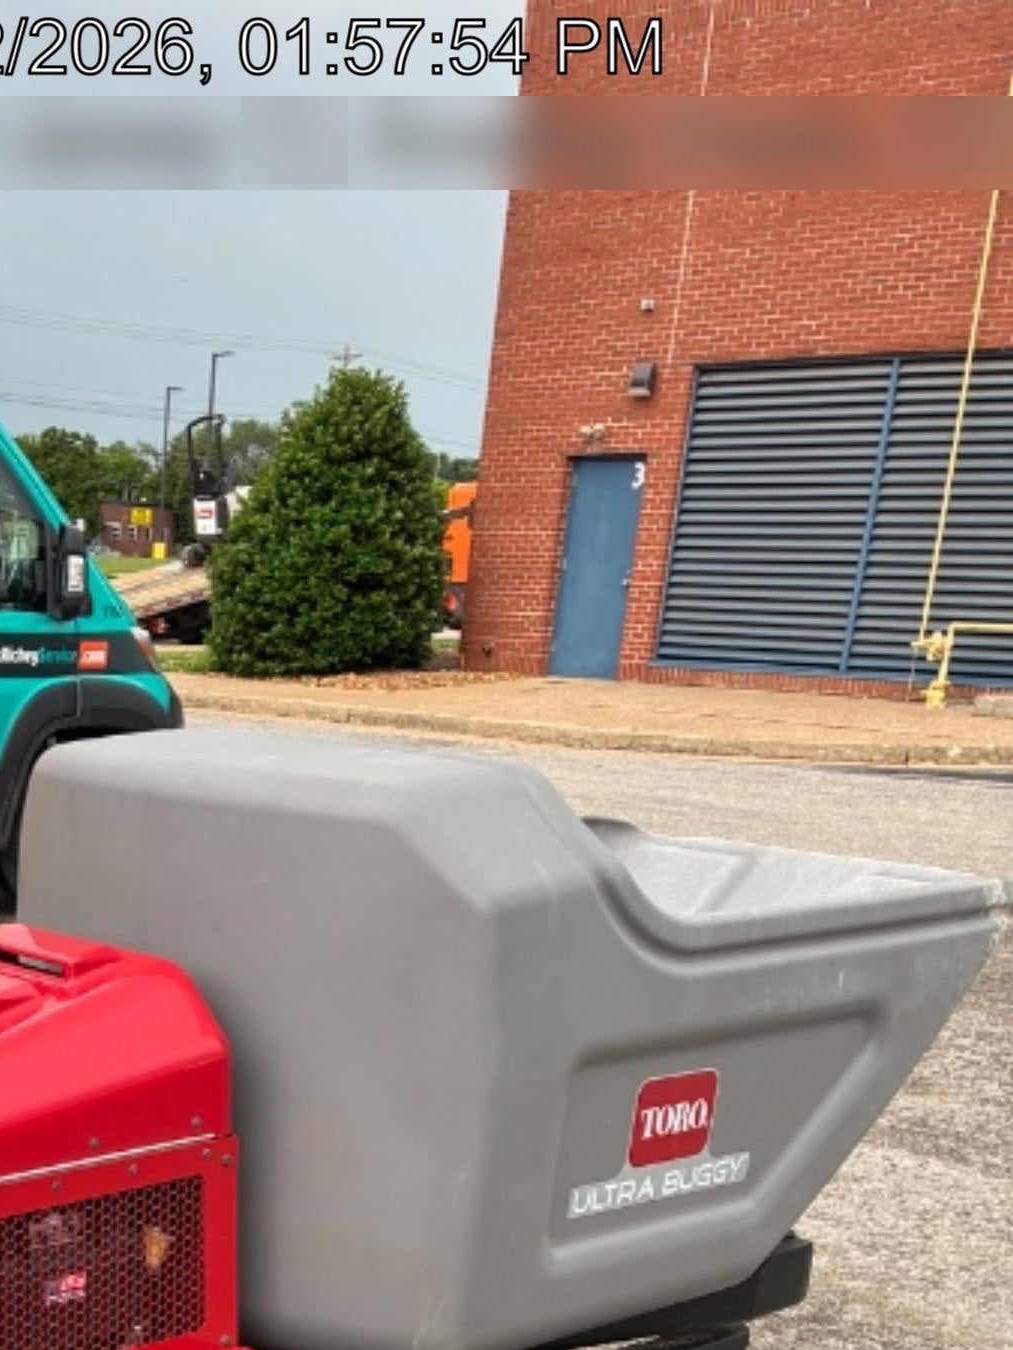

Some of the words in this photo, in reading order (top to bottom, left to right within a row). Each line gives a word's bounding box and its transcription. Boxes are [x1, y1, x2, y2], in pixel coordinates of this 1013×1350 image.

[631, 461, 646, 489] 3
[640, 1098, 709, 1140] TORO
[572, 1175, 655, 1215] ULTRA
[663, 1156, 747, 1195] BUGGY
